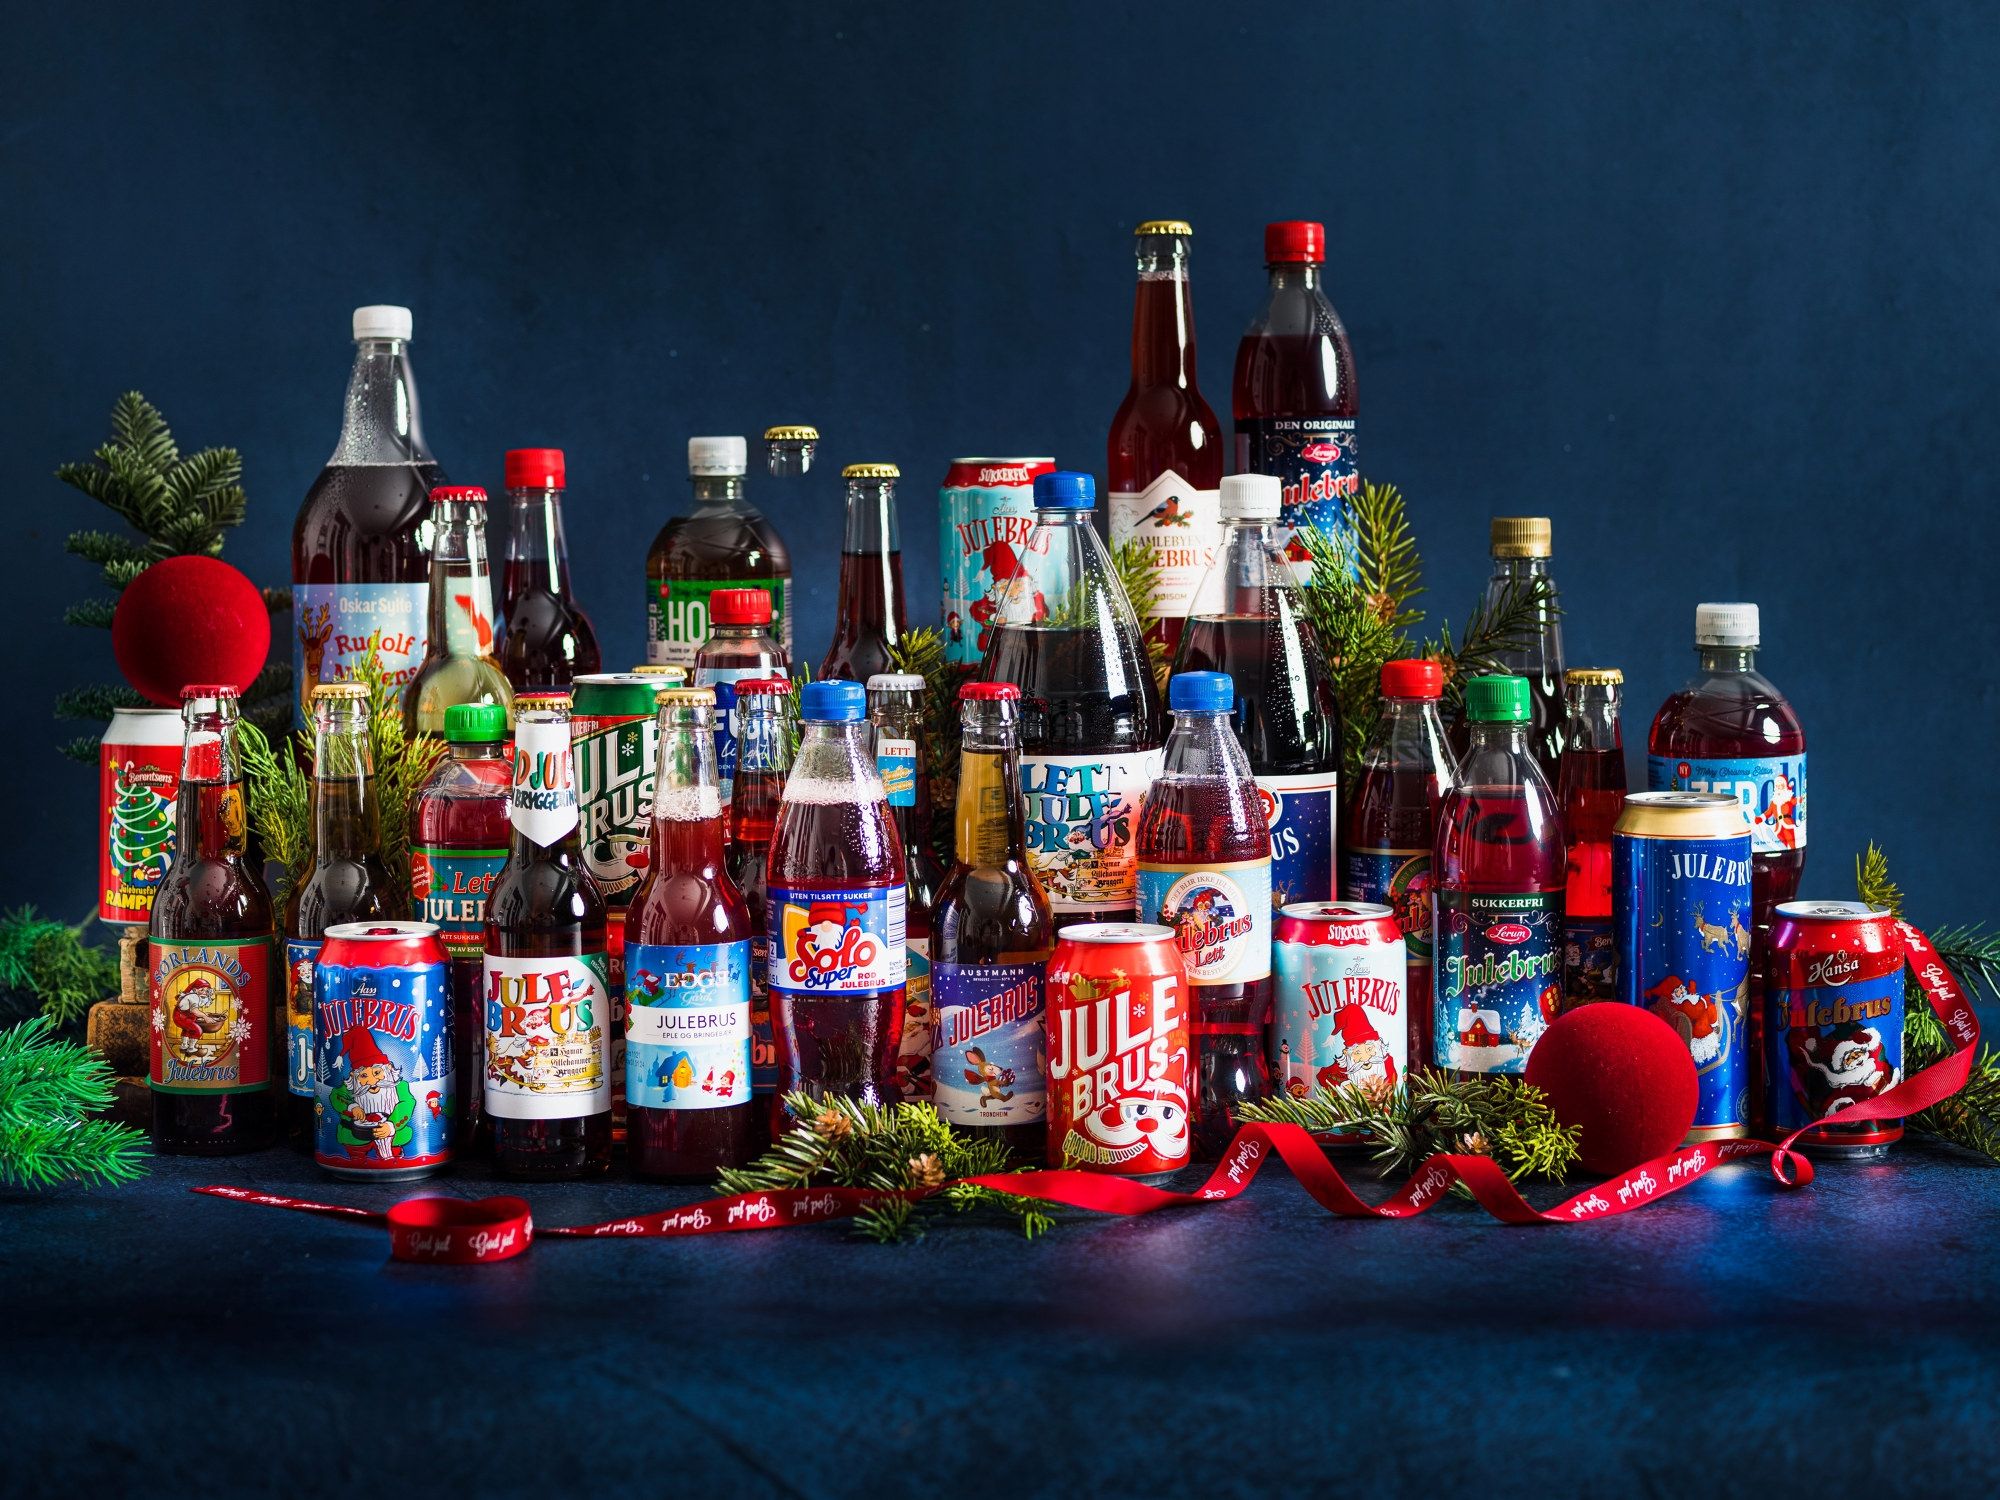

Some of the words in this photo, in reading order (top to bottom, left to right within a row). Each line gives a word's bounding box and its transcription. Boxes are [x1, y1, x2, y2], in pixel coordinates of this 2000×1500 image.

[1275, 421, 1300, 430] DEN
[978, 466, 1030, 483] SUKKERFRI
[1283, 469, 1360, 506] ulebru
[340, 597, 374, 614] Oskar
[378, 597, 413, 617] Sylte
[668, 600, 716, 644] HO
[571, 721, 599, 738] KKERFRI
[885, 747, 911, 756] LETT
[129, 772, 173, 784] Berentsens
[1678, 765, 1689, 775] NY
[1024, 790, 1112, 825] JULE
[1024, 817, 1131, 853] BRUS
[789, 892, 809, 900] UTEN
[810, 892, 841, 900] TILSATT
[842, 891, 873, 900] SUKKER
[1180, 879, 1197, 890] BLIR
[1471, 898, 1544, 909] SUKKERFRI
[1174, 914, 1253, 954] ulebrus
[1489, 926, 1527, 943] Lerum
[788, 925, 878, 984] Solo
[1194, 945, 1226, 967] Lett
[804, 965, 858, 990] Super
[839, 978, 886, 989] JULEBRUS
[857, 972, 877, 980] RØD
[960, 968, 1025, 977] AUSTMANN
[1808, 957, 1859, 986] Hansa
[1921, 963, 1949, 988] God
[351, 982, 377, 996] Aass
[487, 969, 573, 1008] JULE
[1302, 977, 1401, 1021] JULEBRUS
[1931, 986, 1956, 1001] jul
[319, 997, 424, 1042] JULEBRUS
[486, 997, 594, 1038] BRUS
[656, 1012, 737, 1029] JULEBRUS
[948, 975, 1038, 1048] JULEBRUS
[1775, 996, 1892, 1031] Julebrus
[1948, 1009, 1972, 1031] God
[1050, 975, 1180, 1080] JULE
[163, 1057, 239, 1085] Julebrus
[1072, 1036, 1169, 1121] BRUS
[1236, 1141, 1260, 1169] God
[1683, 1149, 1707, 1177] God
[1227, 1159, 1244, 1184] jul
[1422, 1166, 1449, 1196] God
[1667, 1158, 1682, 1183] jul
[1409, 1183, 1425, 1207] jul
[1617, 1179, 1633, 1204] jul
[1633, 1171, 1657, 1197] God
[680, 1208, 712, 1229] God
[727, 1200, 745, 1223] jul
[745, 1196, 777, 1222] God
[661, 1213, 680, 1232] jul
[467, 1230, 501, 1258] God
[498, 1227, 516, 1254] jul
